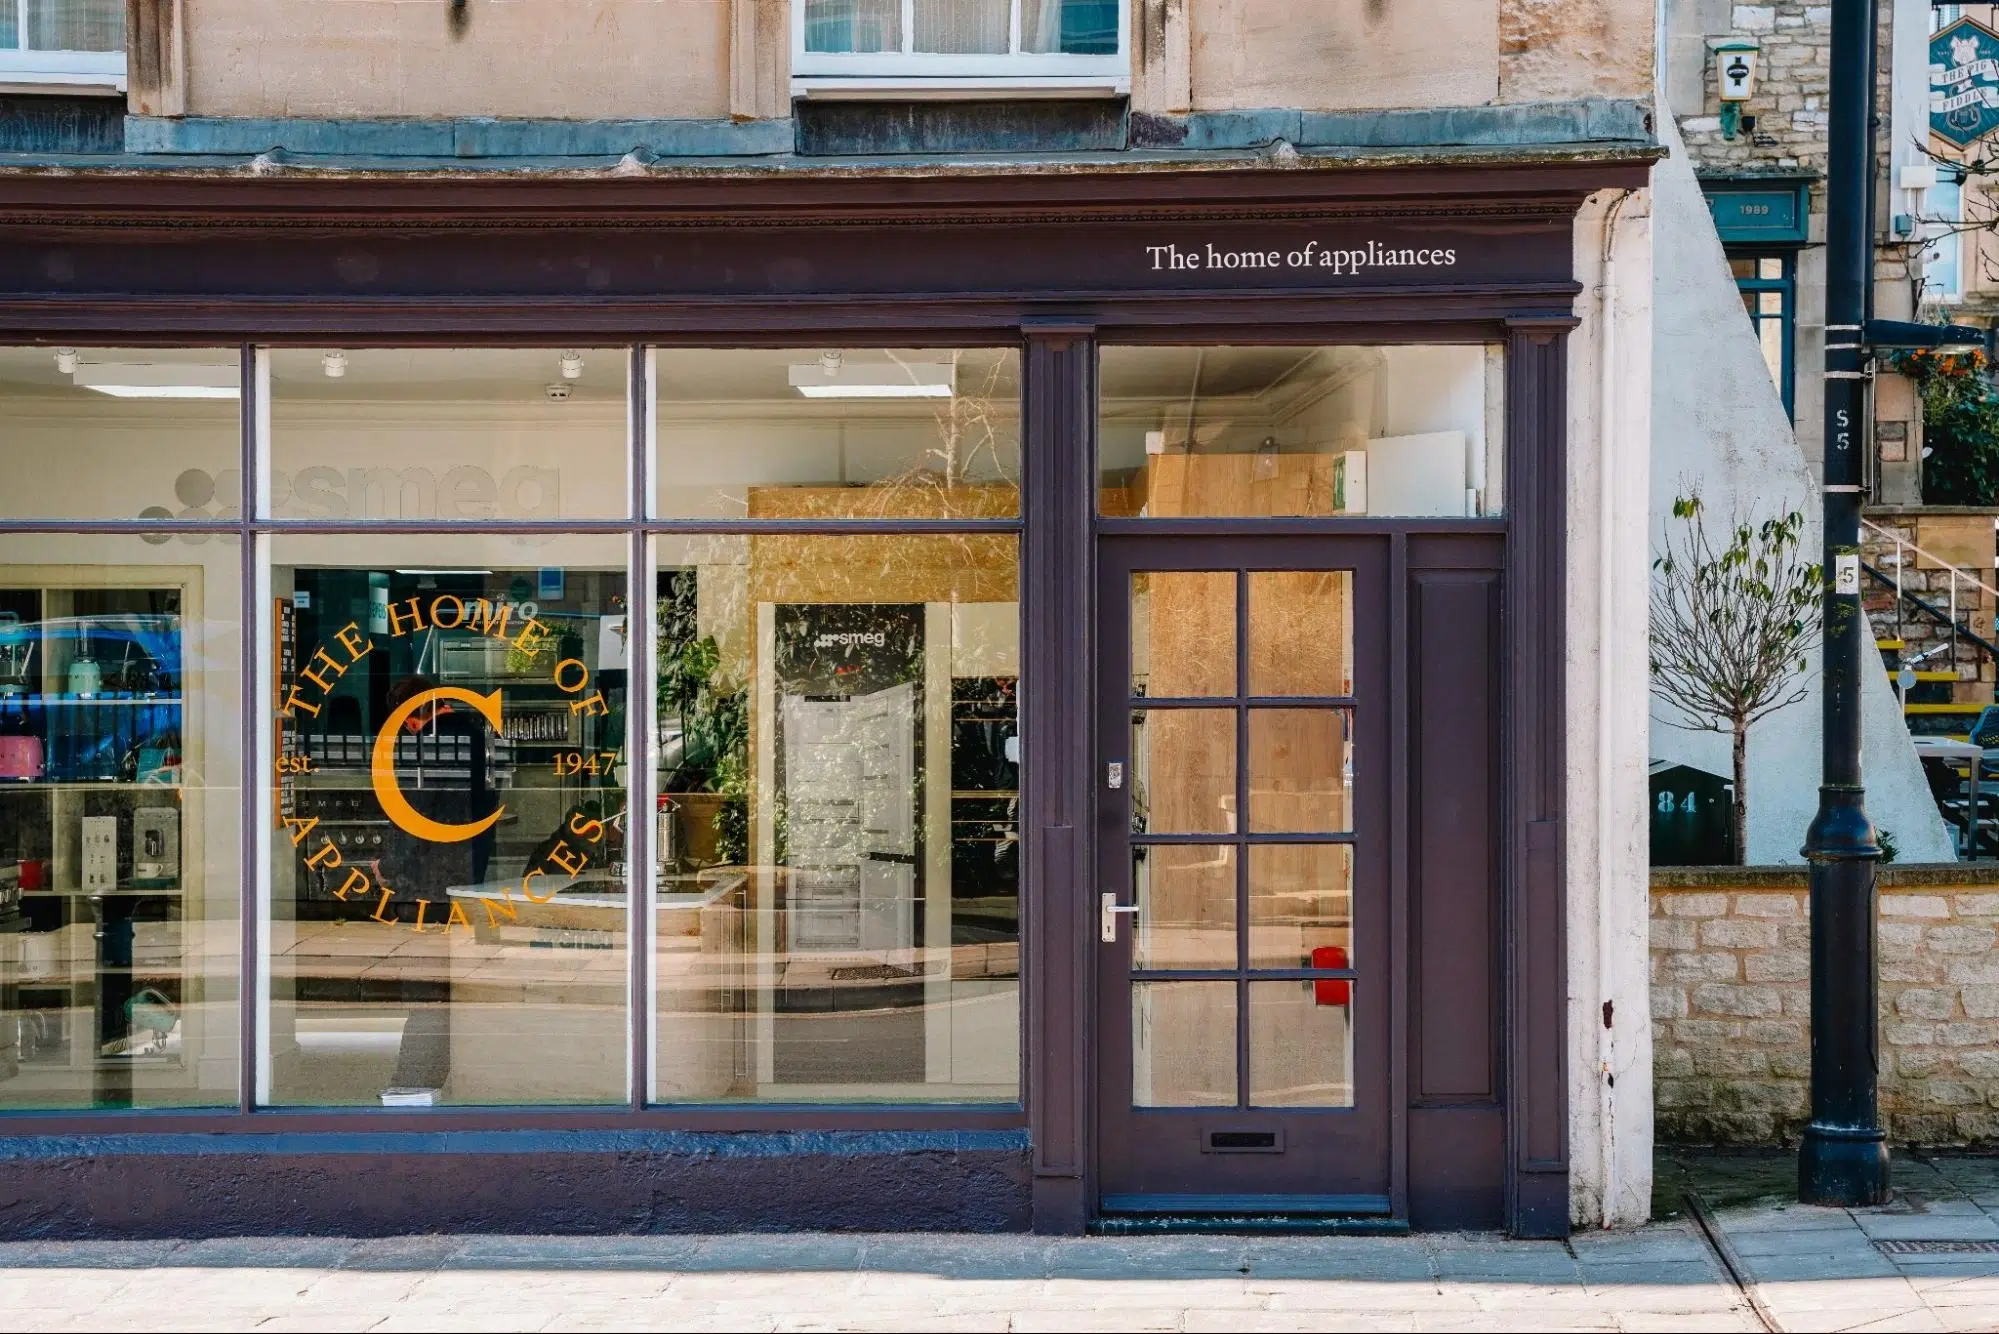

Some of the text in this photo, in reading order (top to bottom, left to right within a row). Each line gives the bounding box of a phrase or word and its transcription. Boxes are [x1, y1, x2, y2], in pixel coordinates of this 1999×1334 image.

[1740, 205, 1769, 216] 1989
[1146, 240, 1457, 275] The home of appliances
[838, 632, 885, 647] smeg
[282, 621, 374, 719] THE
[386, 594, 550, 658] HOME
[554, 658, 609, 717] OF
[275, 755, 319, 773] est.
[371, 686, 505, 843] C
[552, 752, 618, 776] 1947
[1657, 791, 1697, 813] 84
[281, 814, 603, 934] APPLIANCES
